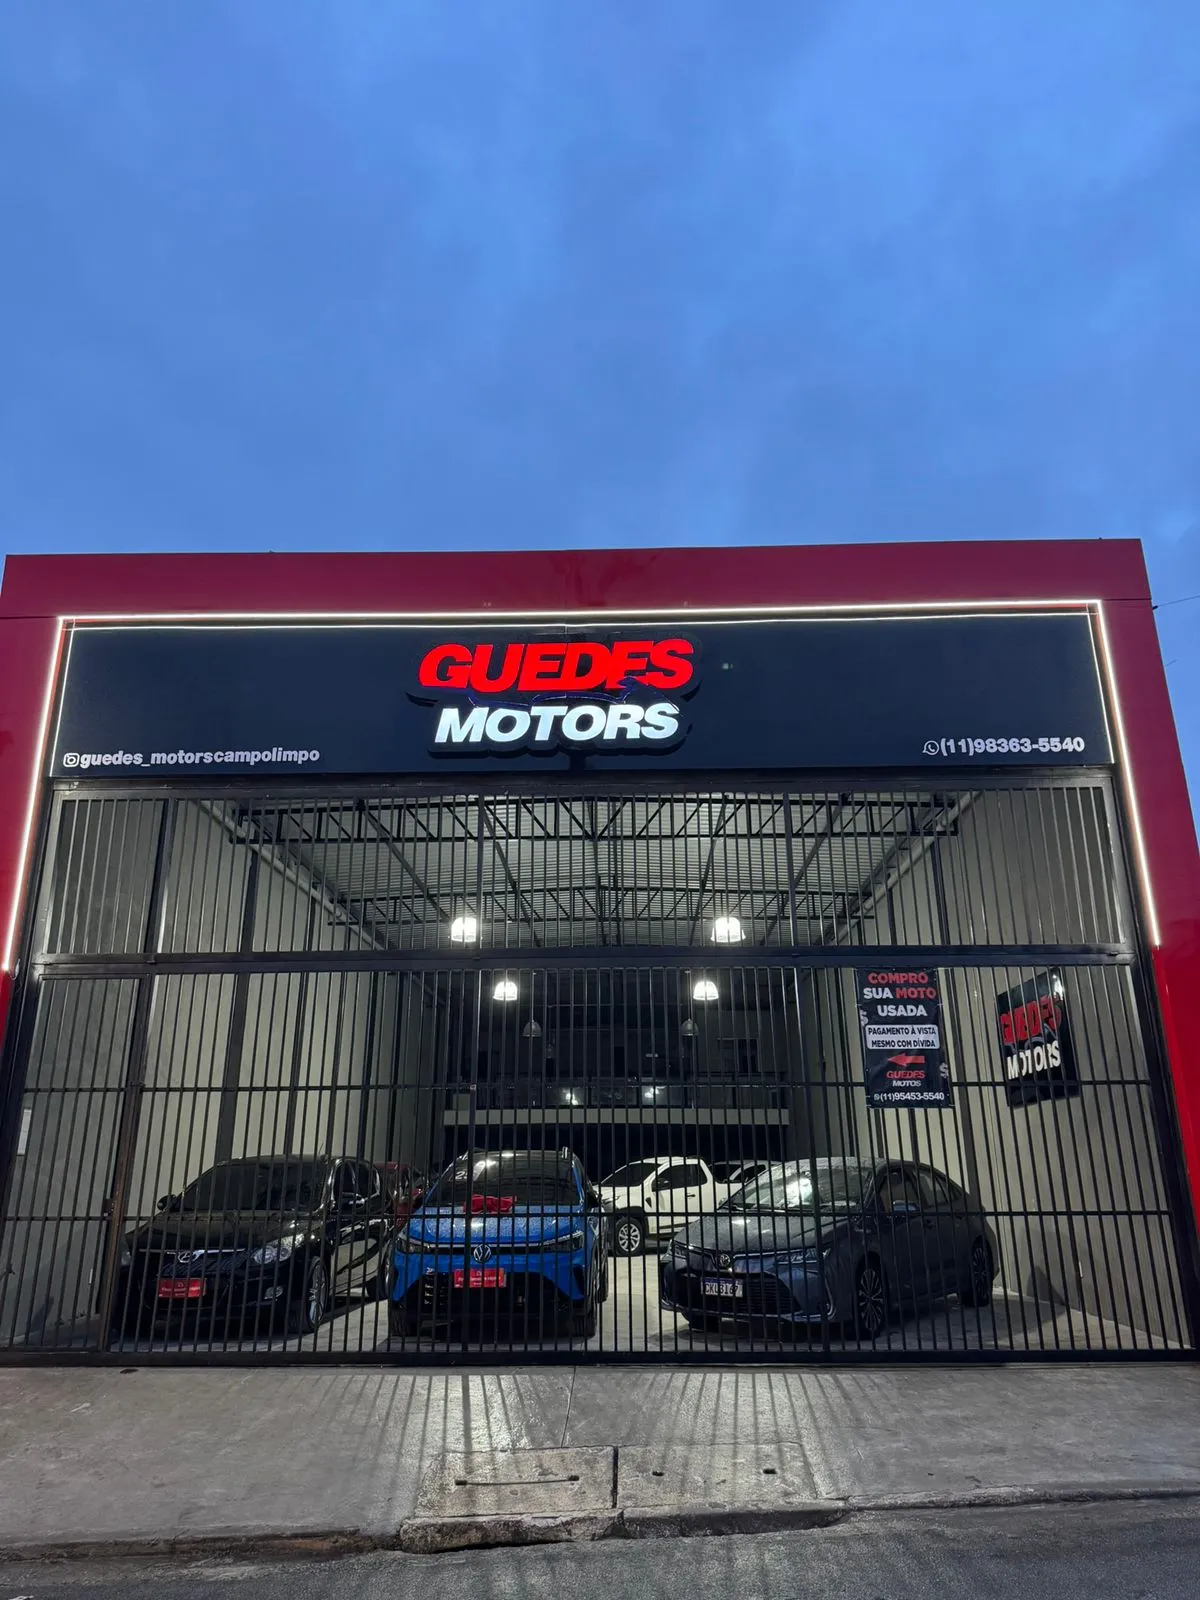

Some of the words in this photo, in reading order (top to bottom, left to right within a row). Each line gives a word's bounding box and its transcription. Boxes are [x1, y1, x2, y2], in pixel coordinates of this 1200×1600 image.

[418, 638, 694, 693] GUEDES
[434, 702, 680, 743] MOTORS
[940, 736, 1086, 757] (11)98363-5540
[80, 747, 320, 768] guedes_motorscampolimpo
[868, 972, 928, 984] COMPRO
[863, 988, 893, 999] SUA
[895, 988, 936, 1000] MOTO
[877, 1004, 927, 1016] USADA
[868, 1027, 909, 1035] PAGAMENTO
[917, 1027, 936, 1035] VISTA
[871, 1040, 896, 1048] MESMO
[897, 1040, 912, 1048] COM
